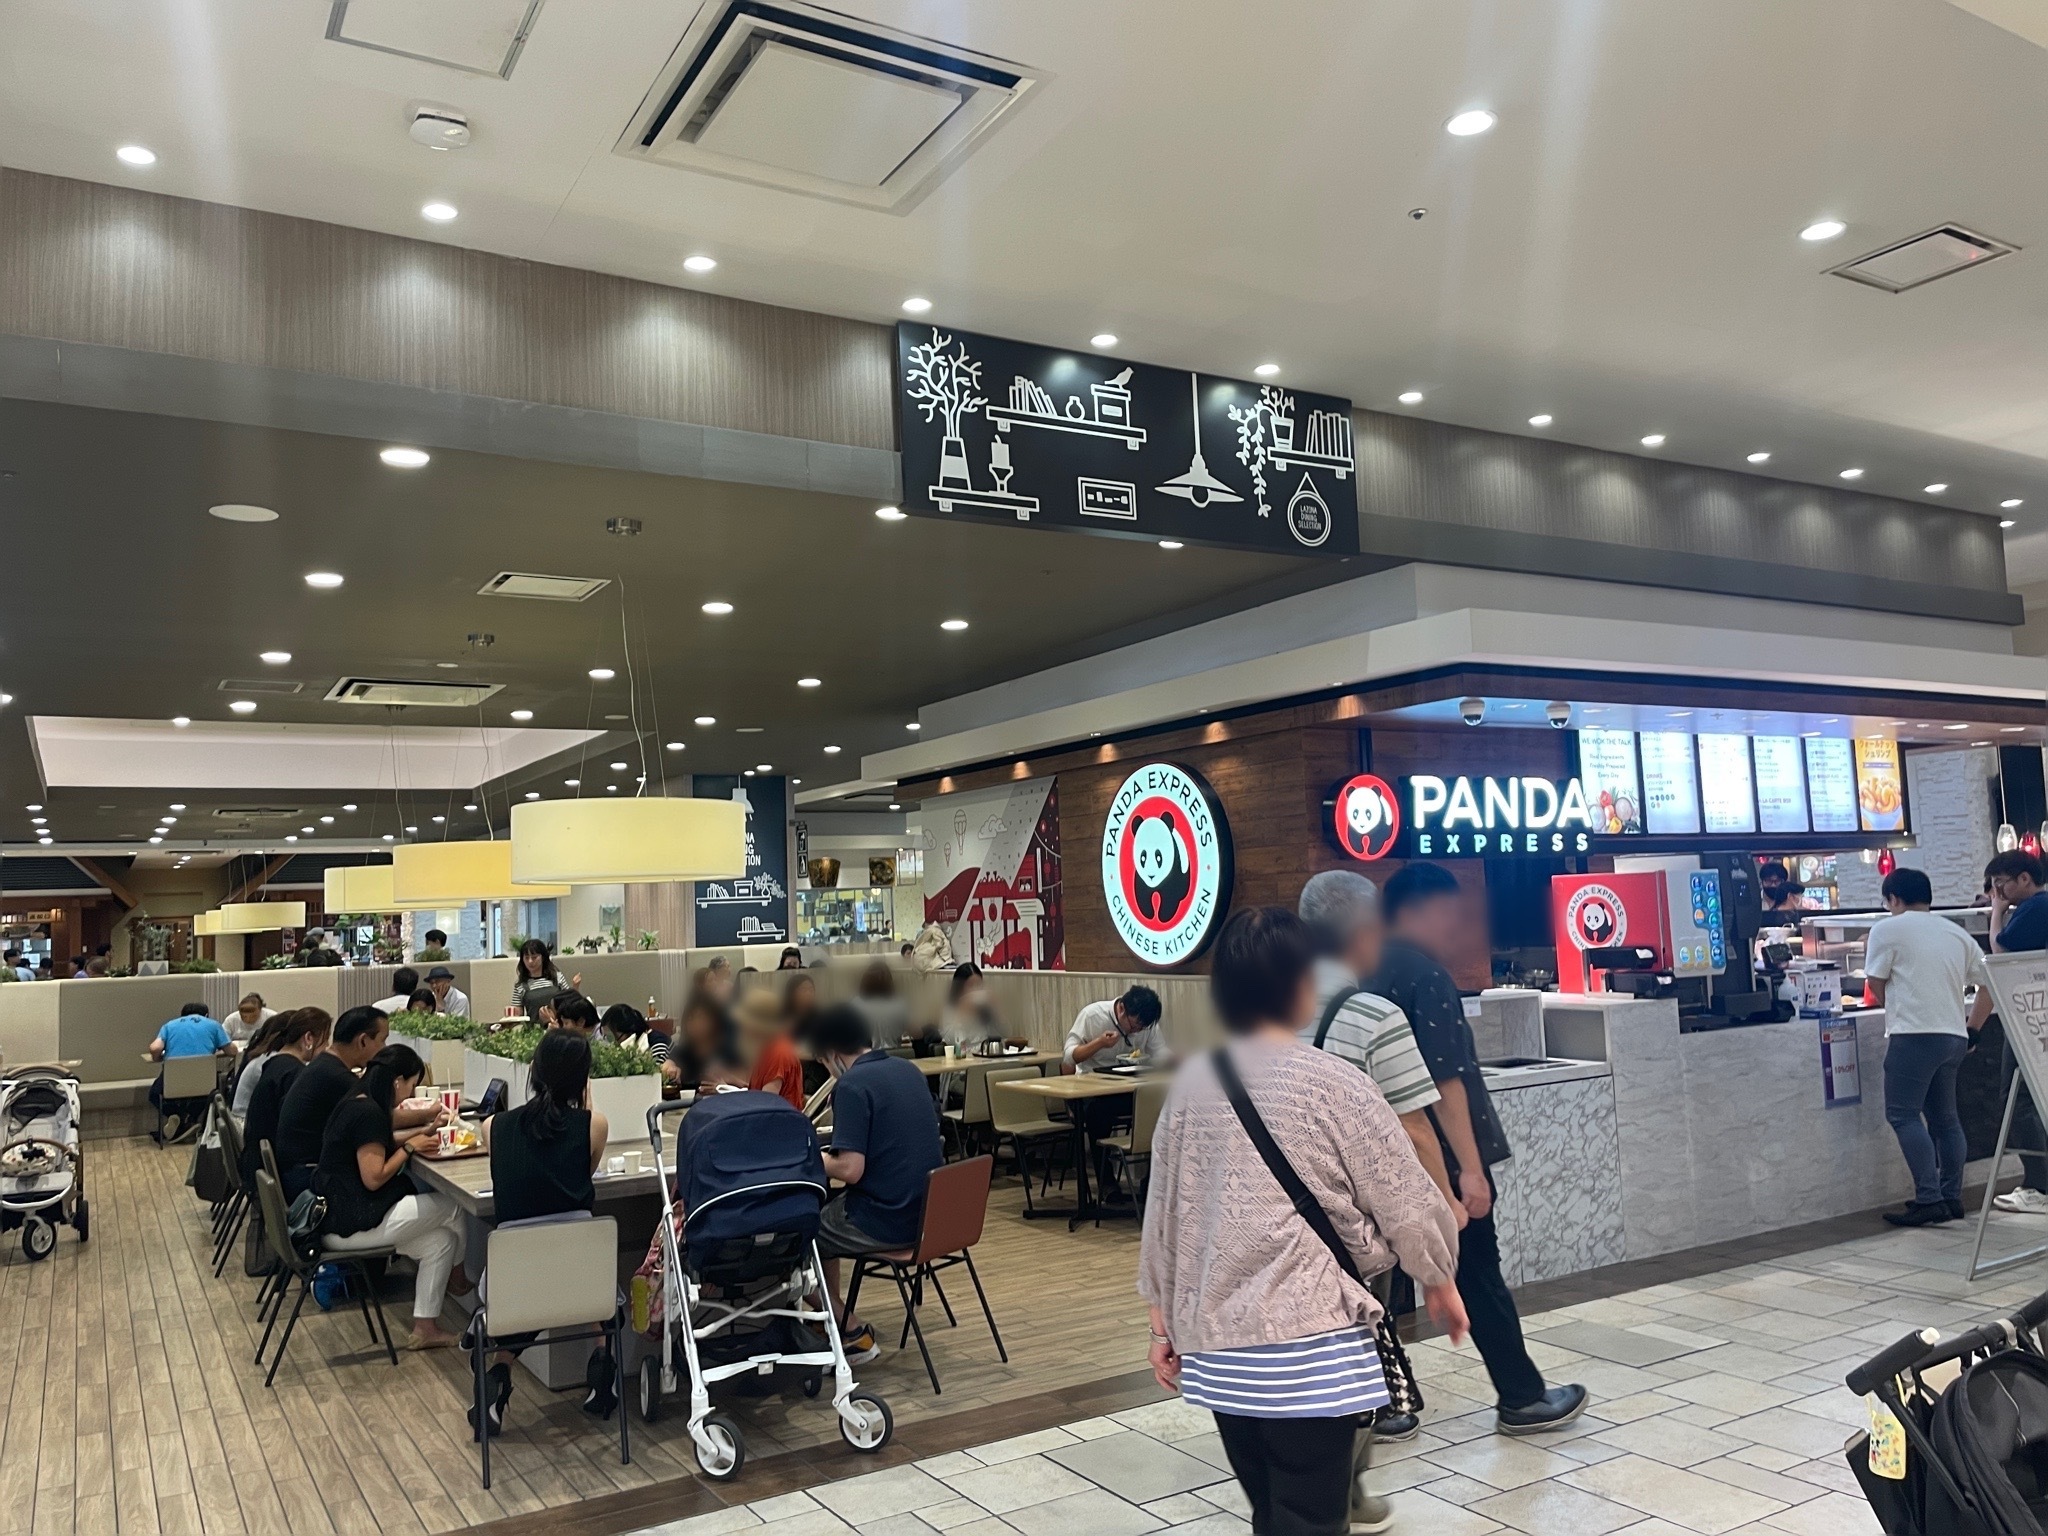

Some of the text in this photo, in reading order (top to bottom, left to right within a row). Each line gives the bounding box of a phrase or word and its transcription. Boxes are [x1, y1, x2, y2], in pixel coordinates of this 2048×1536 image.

[1298, 520, 1322, 530] SELECTION
[1106, 771, 1213, 857] PANDA EXPRESS
[1410, 775, 1593, 829] PANDA
[1419, 833, 1588, 854] EXPRESS
[1112, 888, 1211, 955] CHINESE KITCHEN
[1569, 886, 1624, 918] PANDA EXPRESS
